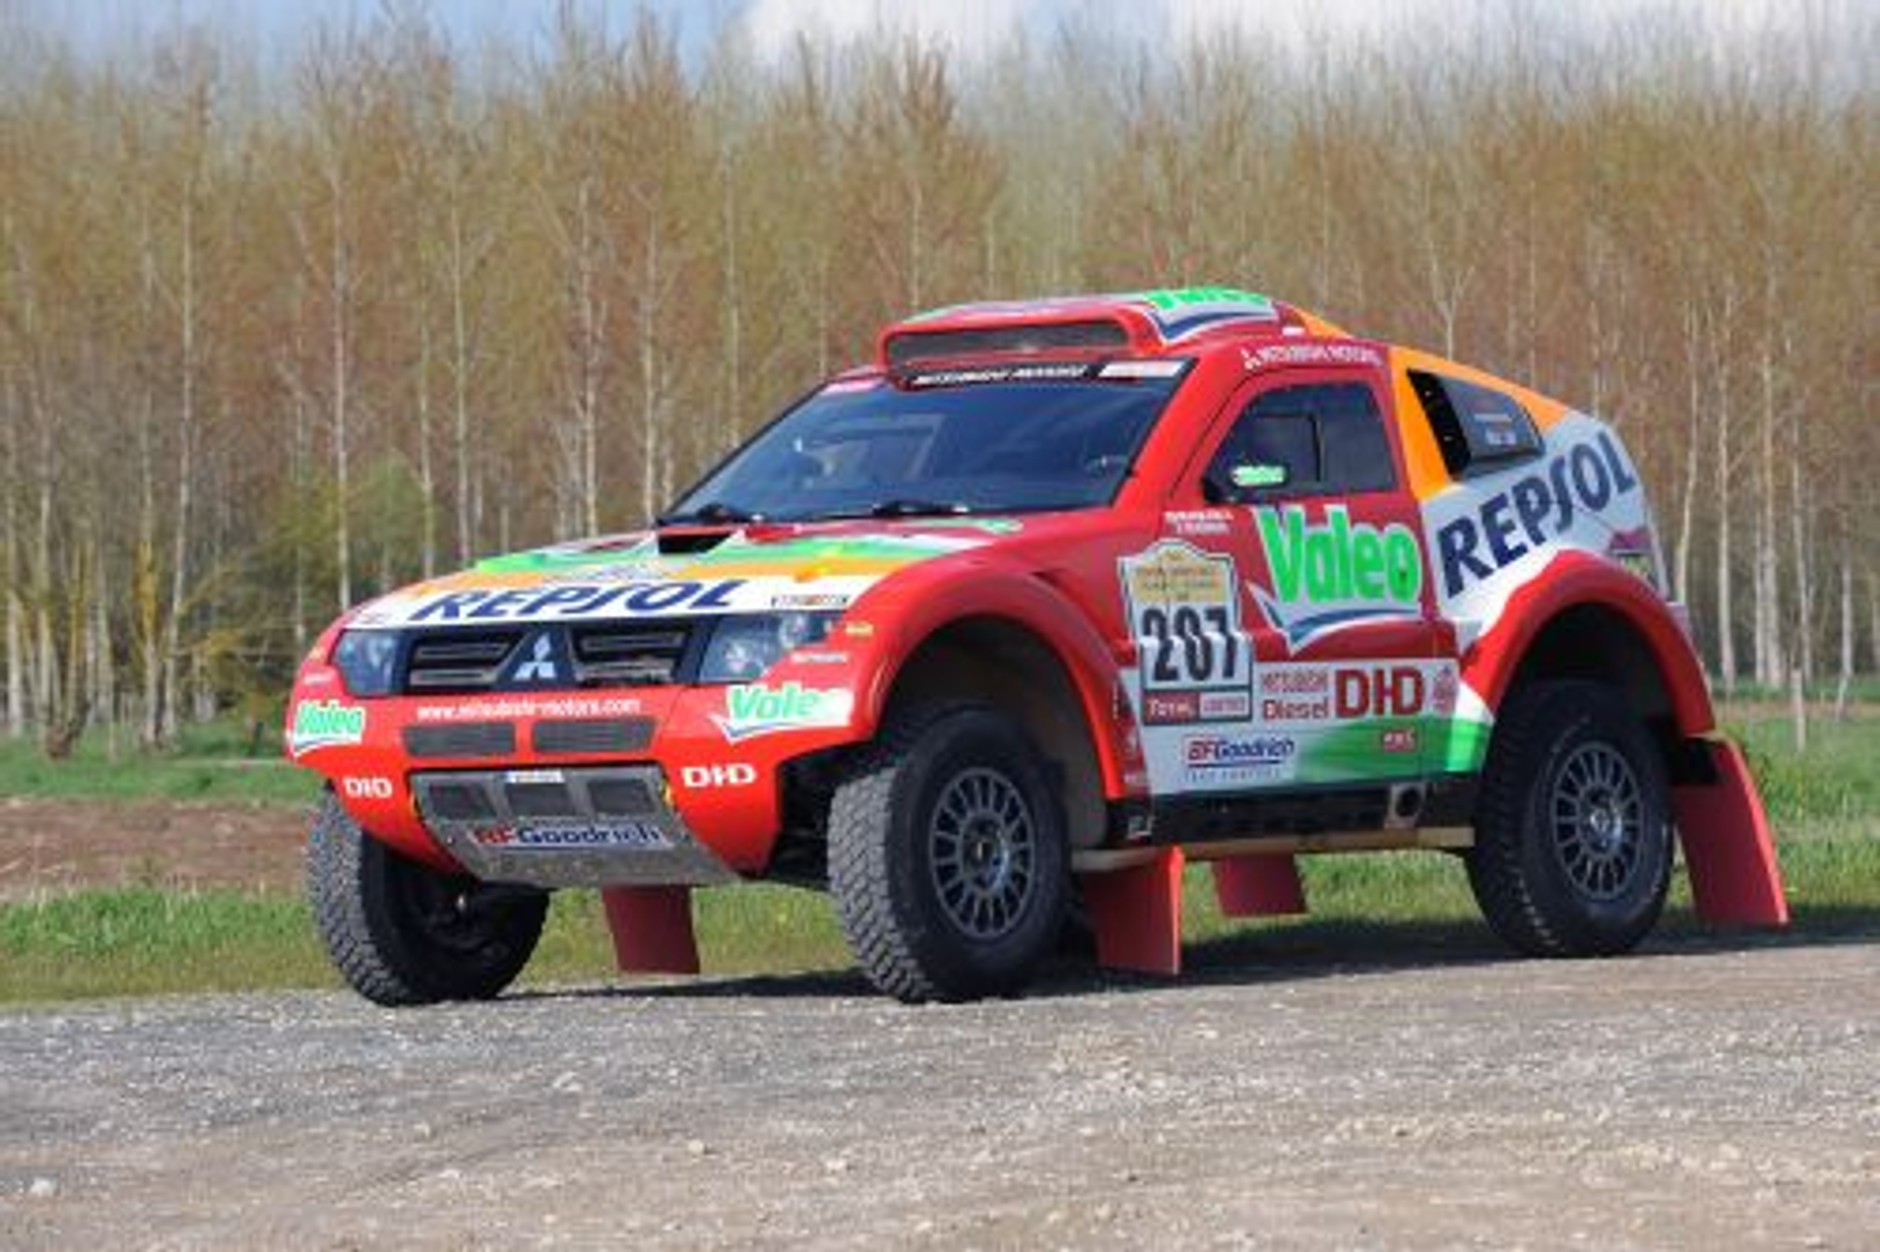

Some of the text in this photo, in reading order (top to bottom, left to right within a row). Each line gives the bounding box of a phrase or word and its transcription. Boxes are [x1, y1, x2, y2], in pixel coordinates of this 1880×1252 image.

[1437, 430, 1637, 599] REPSOL
[1259, 508, 1419, 602] Valeo
[409, 579, 749, 621] REPSOL
[1142, 606, 1239, 682] 207
[731, 685, 842, 721] Vale
